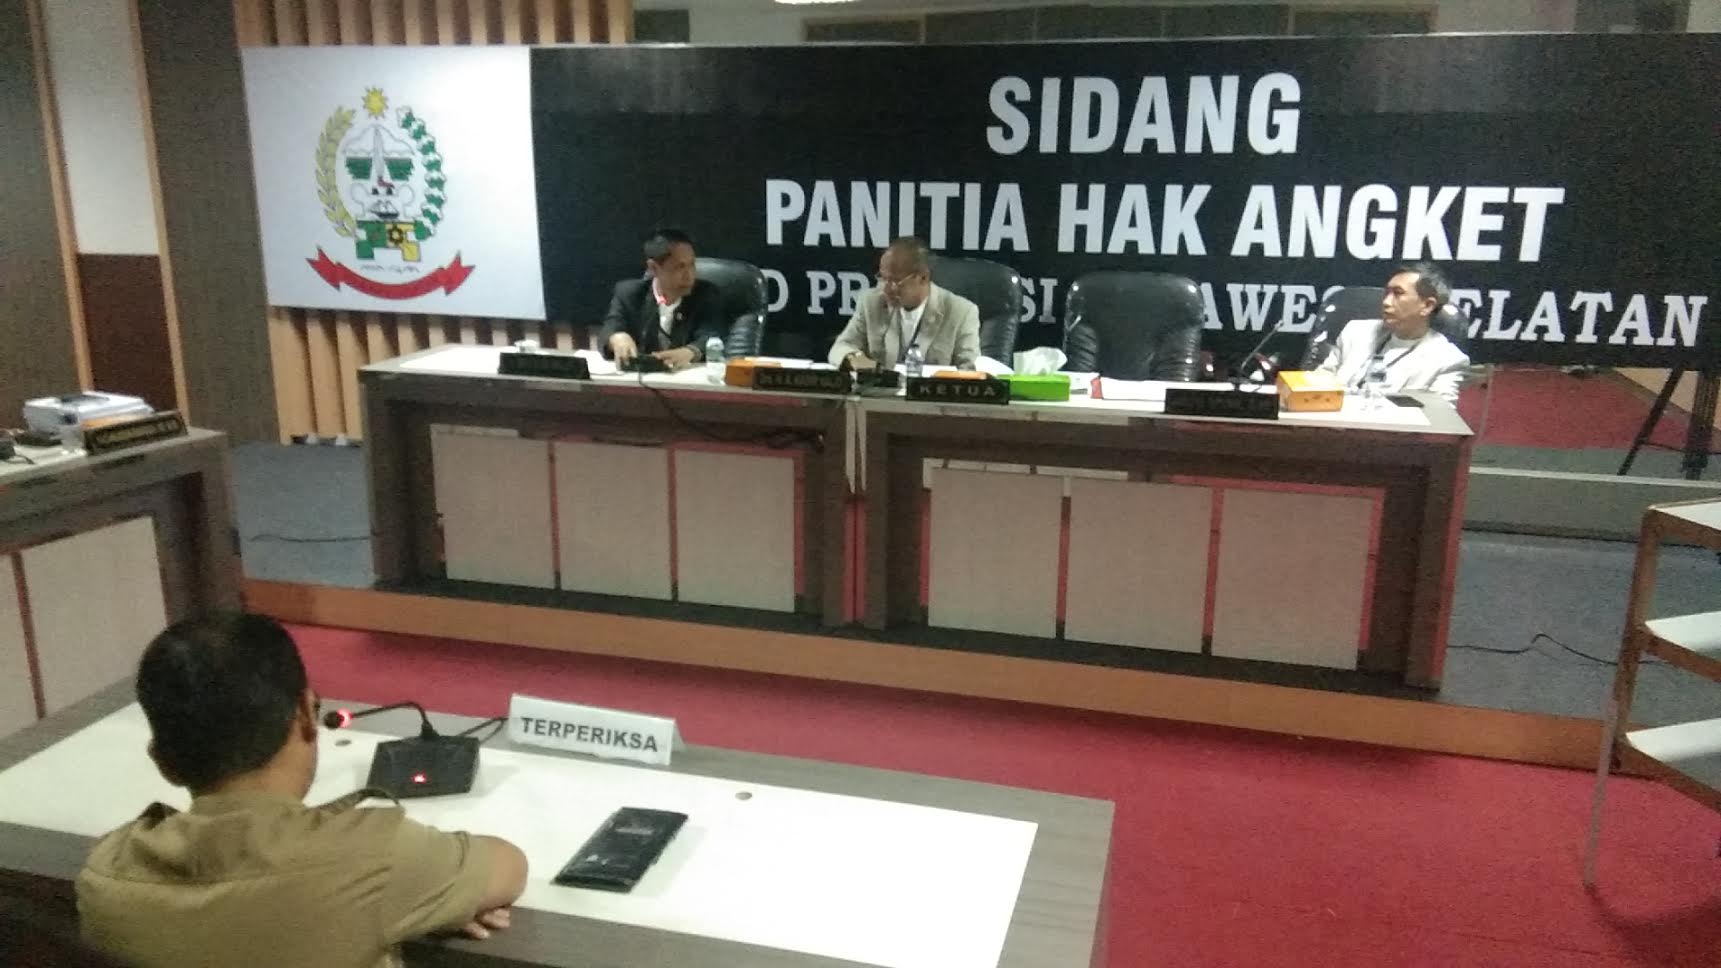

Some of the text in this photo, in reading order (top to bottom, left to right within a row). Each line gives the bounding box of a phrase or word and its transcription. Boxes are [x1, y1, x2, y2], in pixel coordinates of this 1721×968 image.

[987, 73, 1301, 155] SIDANG
[766, 180, 1566, 262] PANITIA HAK ANGKET
[1448, 288, 1709, 347] ELATAN
[919, 384, 996, 397] KETUA
[521, 717, 658, 752] TERPERIKSA
